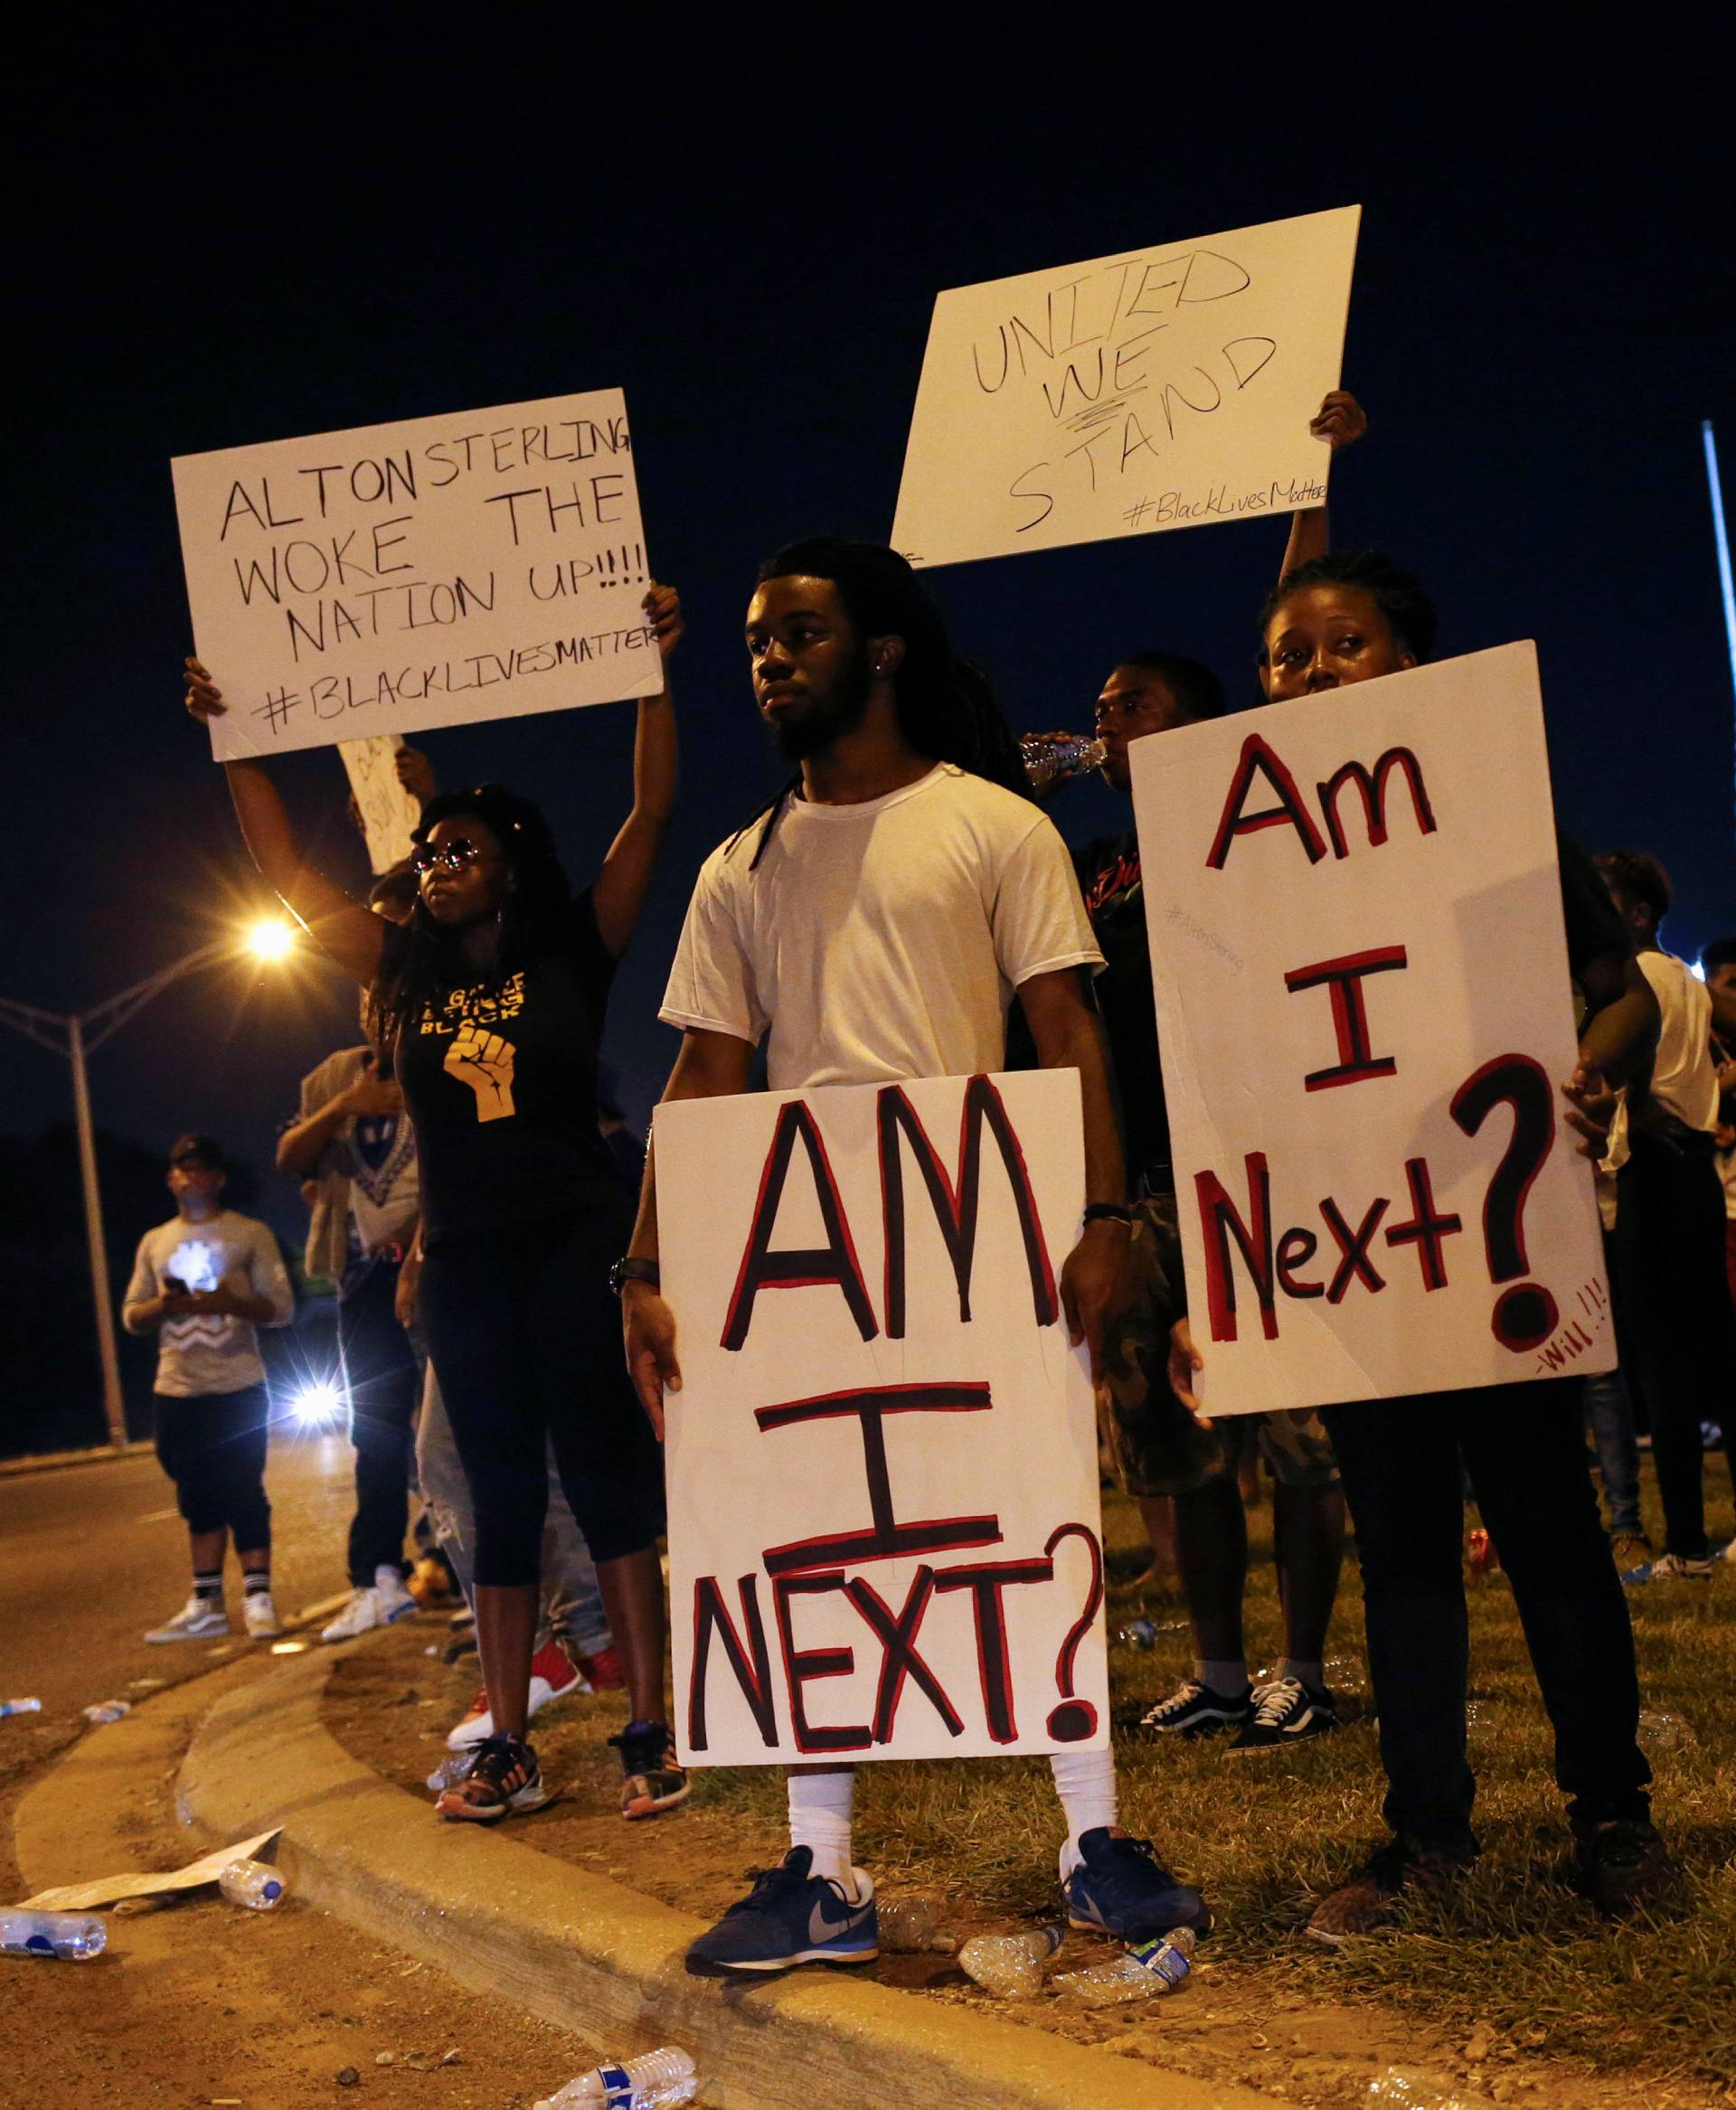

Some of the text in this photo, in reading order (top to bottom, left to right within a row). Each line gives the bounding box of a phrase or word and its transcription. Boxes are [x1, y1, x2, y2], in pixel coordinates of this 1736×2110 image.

[972, 249, 1251, 393] UNITED
[1043, 323, 1170, 419] WE
[1009, 336, 1277, 533] STAND
[233, 474, 626, 606] WOKE THE
[285, 542, 646, 663] NATION UP!!!!
[1204, 731, 1438, 871] Am
[1283, 944, 1409, 1093] I
[719, 1072, 1060, 1352] AM
[1193, 1051, 1562, 1354] Next?
[753, 1380, 1005, 1578] I
[687, 1521, 1107, 1755] NEXT?
